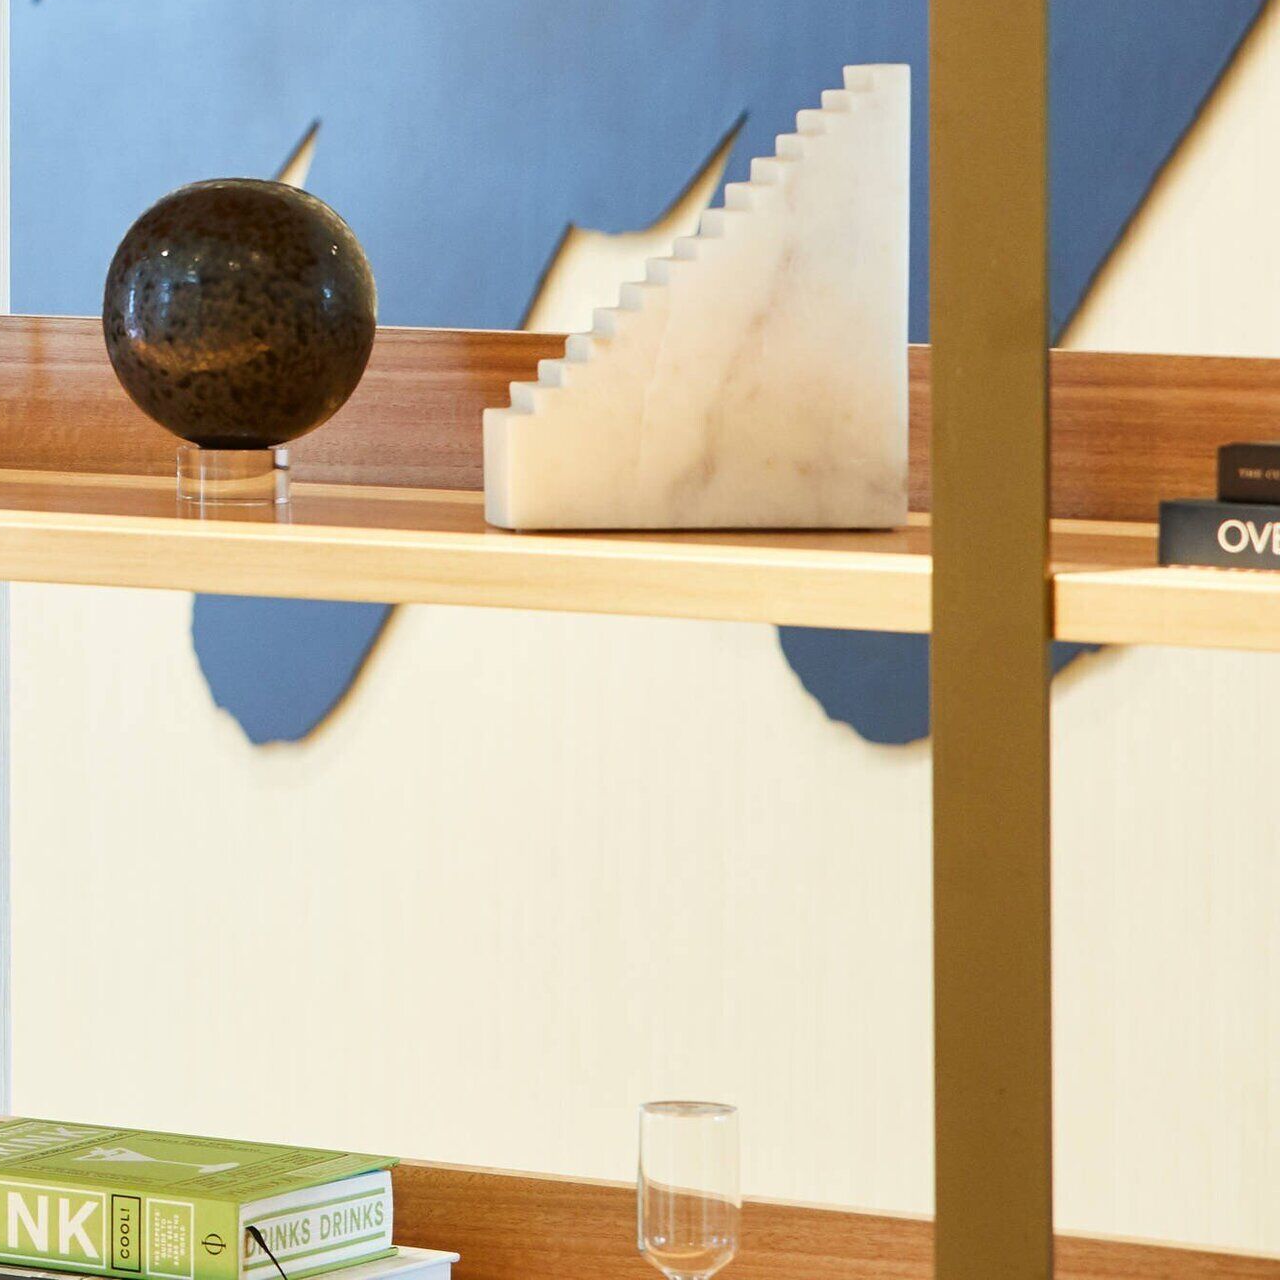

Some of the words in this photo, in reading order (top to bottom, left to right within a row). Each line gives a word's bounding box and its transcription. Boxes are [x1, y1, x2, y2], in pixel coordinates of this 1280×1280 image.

[120, 1208, 130, 1259] COOL!
[244, 1218, 311, 1258] DRINKS
[320, 1201, 384, 1240] DRINKS
